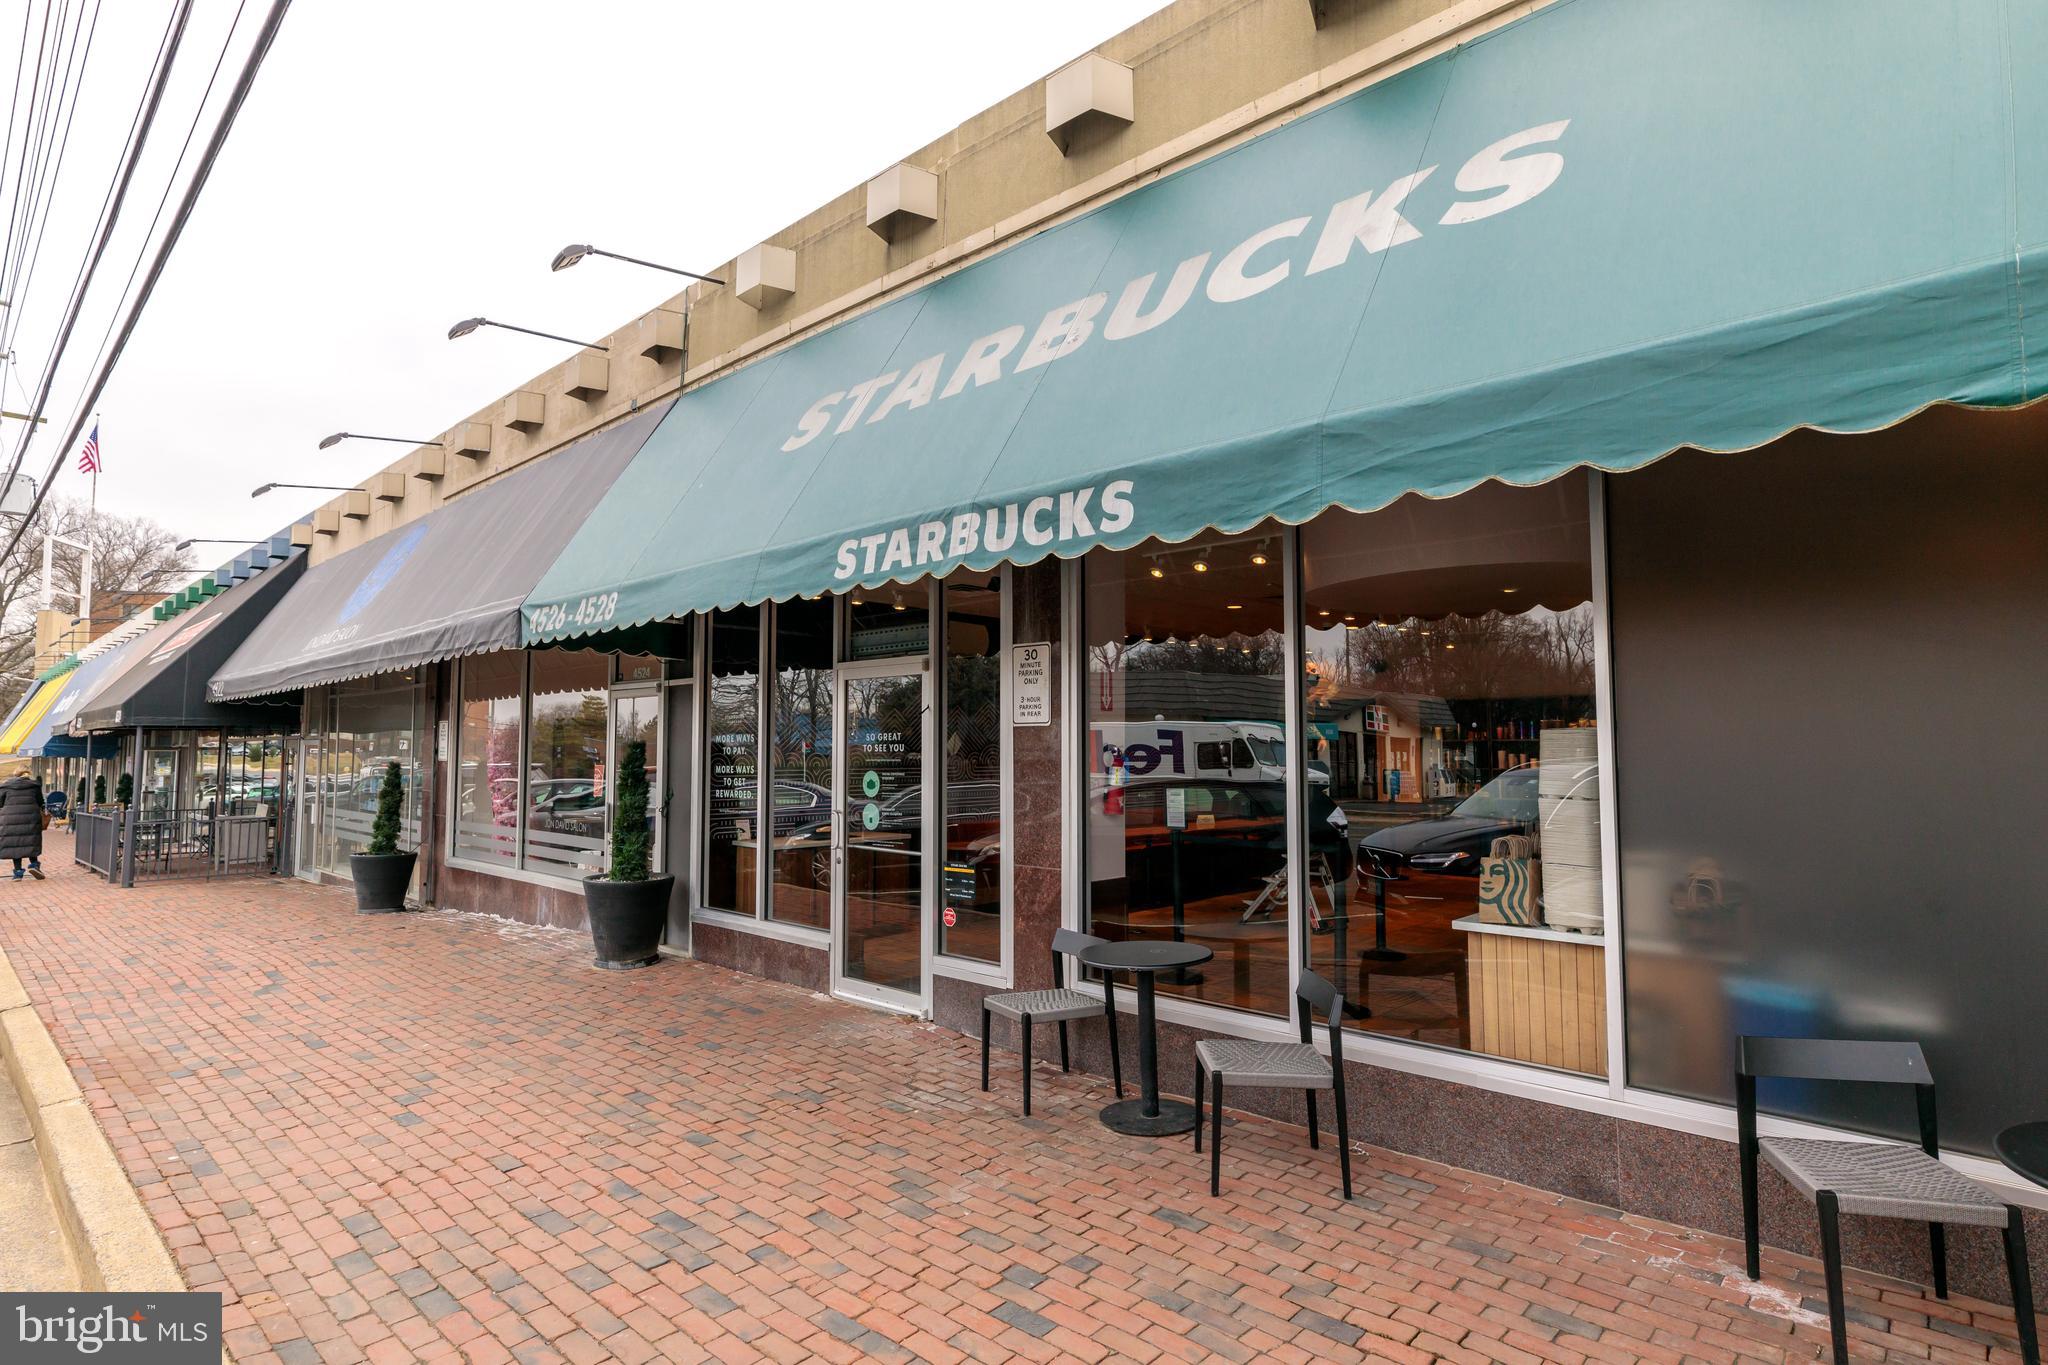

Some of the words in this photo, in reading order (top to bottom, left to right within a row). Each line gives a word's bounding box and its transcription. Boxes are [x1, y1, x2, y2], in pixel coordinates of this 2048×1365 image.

[781, 118, 1571, 454] STARBUCKS
[833, 479, 1135, 580] STARBUCKS
[1024, 649, 1038, 661] 30
[1018, 669, 1043, 677] PARKING
[715, 735, 734, 743] MORE
[736, 733, 755, 742] WAYS
[865, 733, 876, 741] SO
[877, 732, 901, 741] GREAT
[722, 746, 732, 755] TO
[732, 746, 747, 755] PAY.
[862, 744, 873, 752] TO
[874, 744, 887, 752] SEE
[889, 743, 905, 752] YOU
[715, 766, 734, 774] MORE
[736, 765, 755, 774] WAYS
[723, 777, 733, 786] TO
[733, 777, 746, 786] GET
[715, 790, 754, 799] REWARDED.
